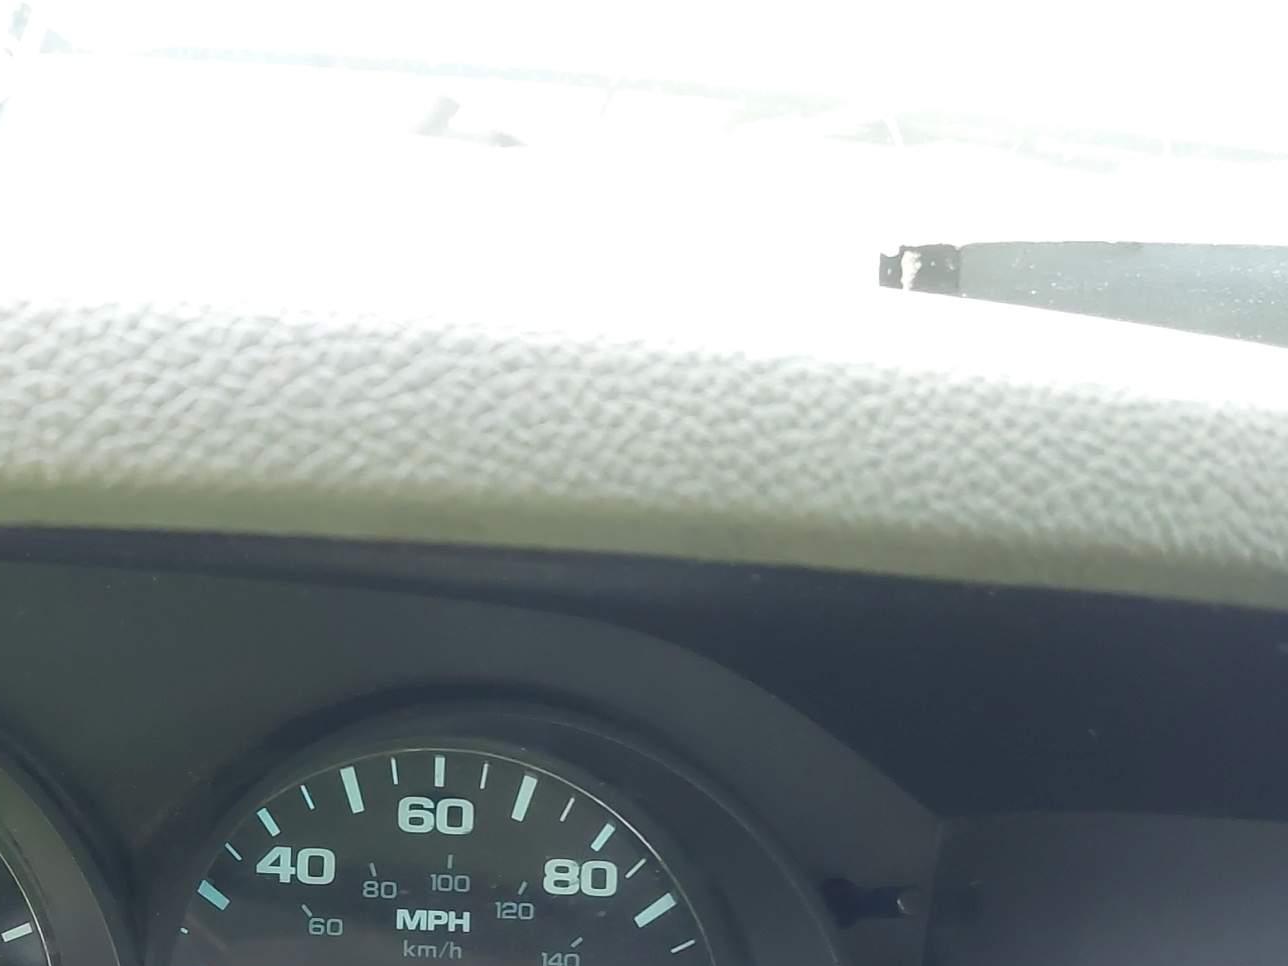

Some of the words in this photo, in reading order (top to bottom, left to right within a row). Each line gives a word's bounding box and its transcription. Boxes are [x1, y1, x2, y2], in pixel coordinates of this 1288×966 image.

[397, 797, 474, 834] 60
[256, 847, 336, 884] 40
[430, 874, 470, 893] 100
[543, 859, 618, 896] 80
[363, 880, 398, 900] 80
[396, 909, 470, 932] MPH
[496, 902, 534, 920] 120
[309, 918, 344, 936] 60
[403, 941, 462, 960] km/h
